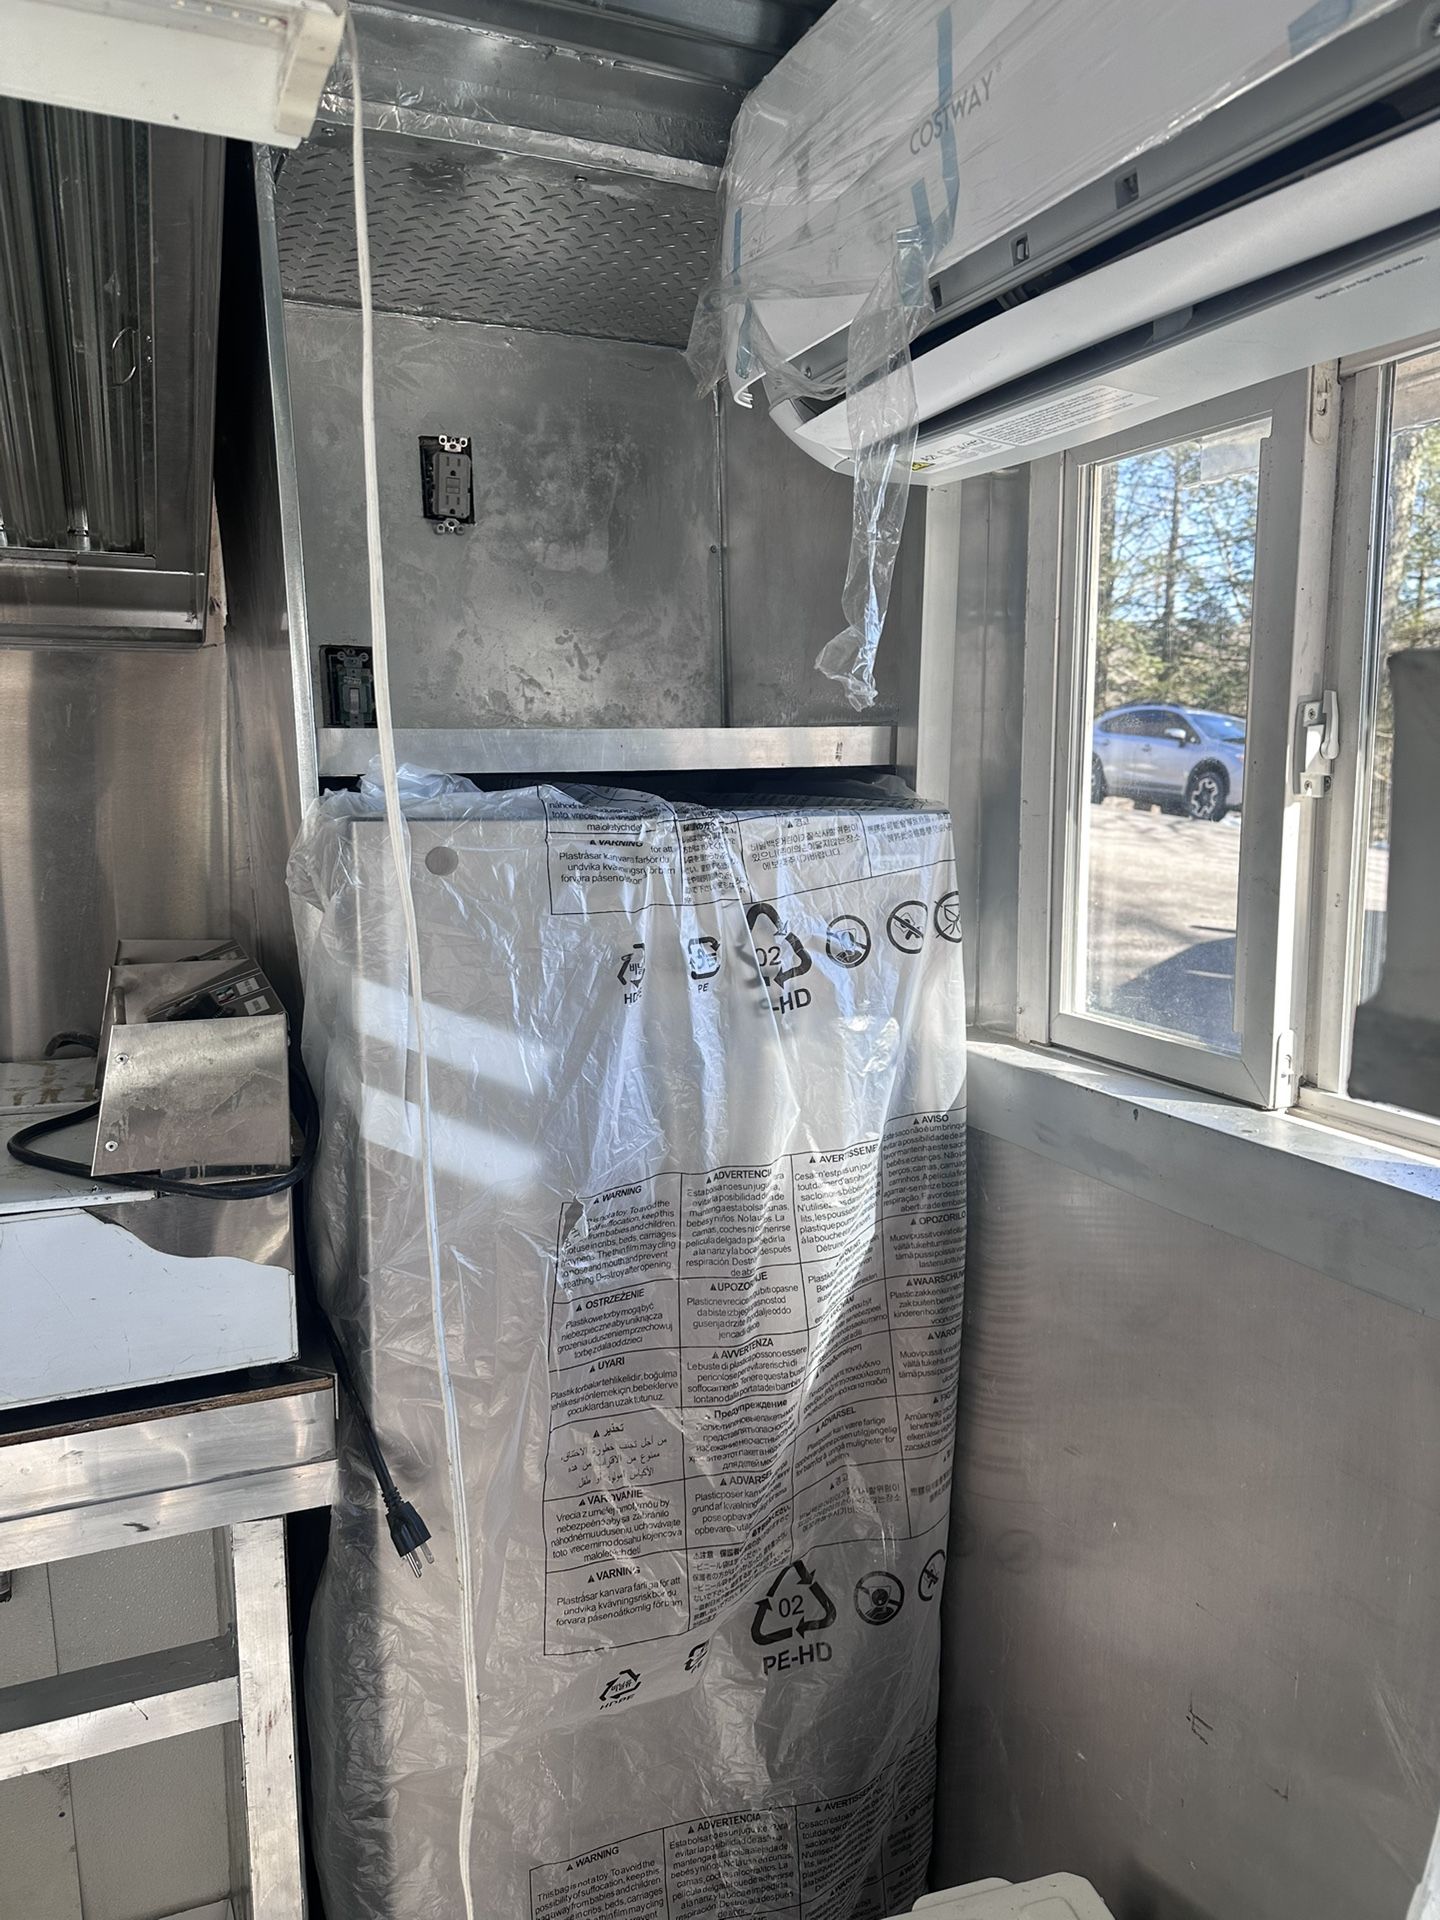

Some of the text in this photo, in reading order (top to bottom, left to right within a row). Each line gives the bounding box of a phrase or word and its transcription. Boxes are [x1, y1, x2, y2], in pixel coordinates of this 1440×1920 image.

[910, 70, 993, 155] COSTWAY
[922, 1114, 949, 1123] AVISO
[602, 1185, 642, 1202] WARNING
[657, 1200, 671, 1208] the
[660, 1208, 675, 1217] this
[644, 1219, 676, 1230] children
[641, 1242, 657, 1252] may
[638, 1251, 668, 1263] prevent
[640, 1260, 672, 1272] opening
[720, 1338, 774, 1359] AVVERTENZA
[598, 1357, 625, 1370] UYARI
[779, 1595, 804, 1618] 02
[763, 1642, 832, 1675] PE-HD
[697, 1813, 761, 1831] ADVERTENCIA
[576, 1846, 619, 1868] WARNING
[538, 1891, 554, 1902] This
[554, 1885, 569, 1896] bag
[578, 1878, 591, 1888] not
[620, 1863, 642, 1874] avoid
[626, 1873, 645, 1884] keep
[646, 1868, 660, 1876] this
[630, 1877, 661, 1891] children
